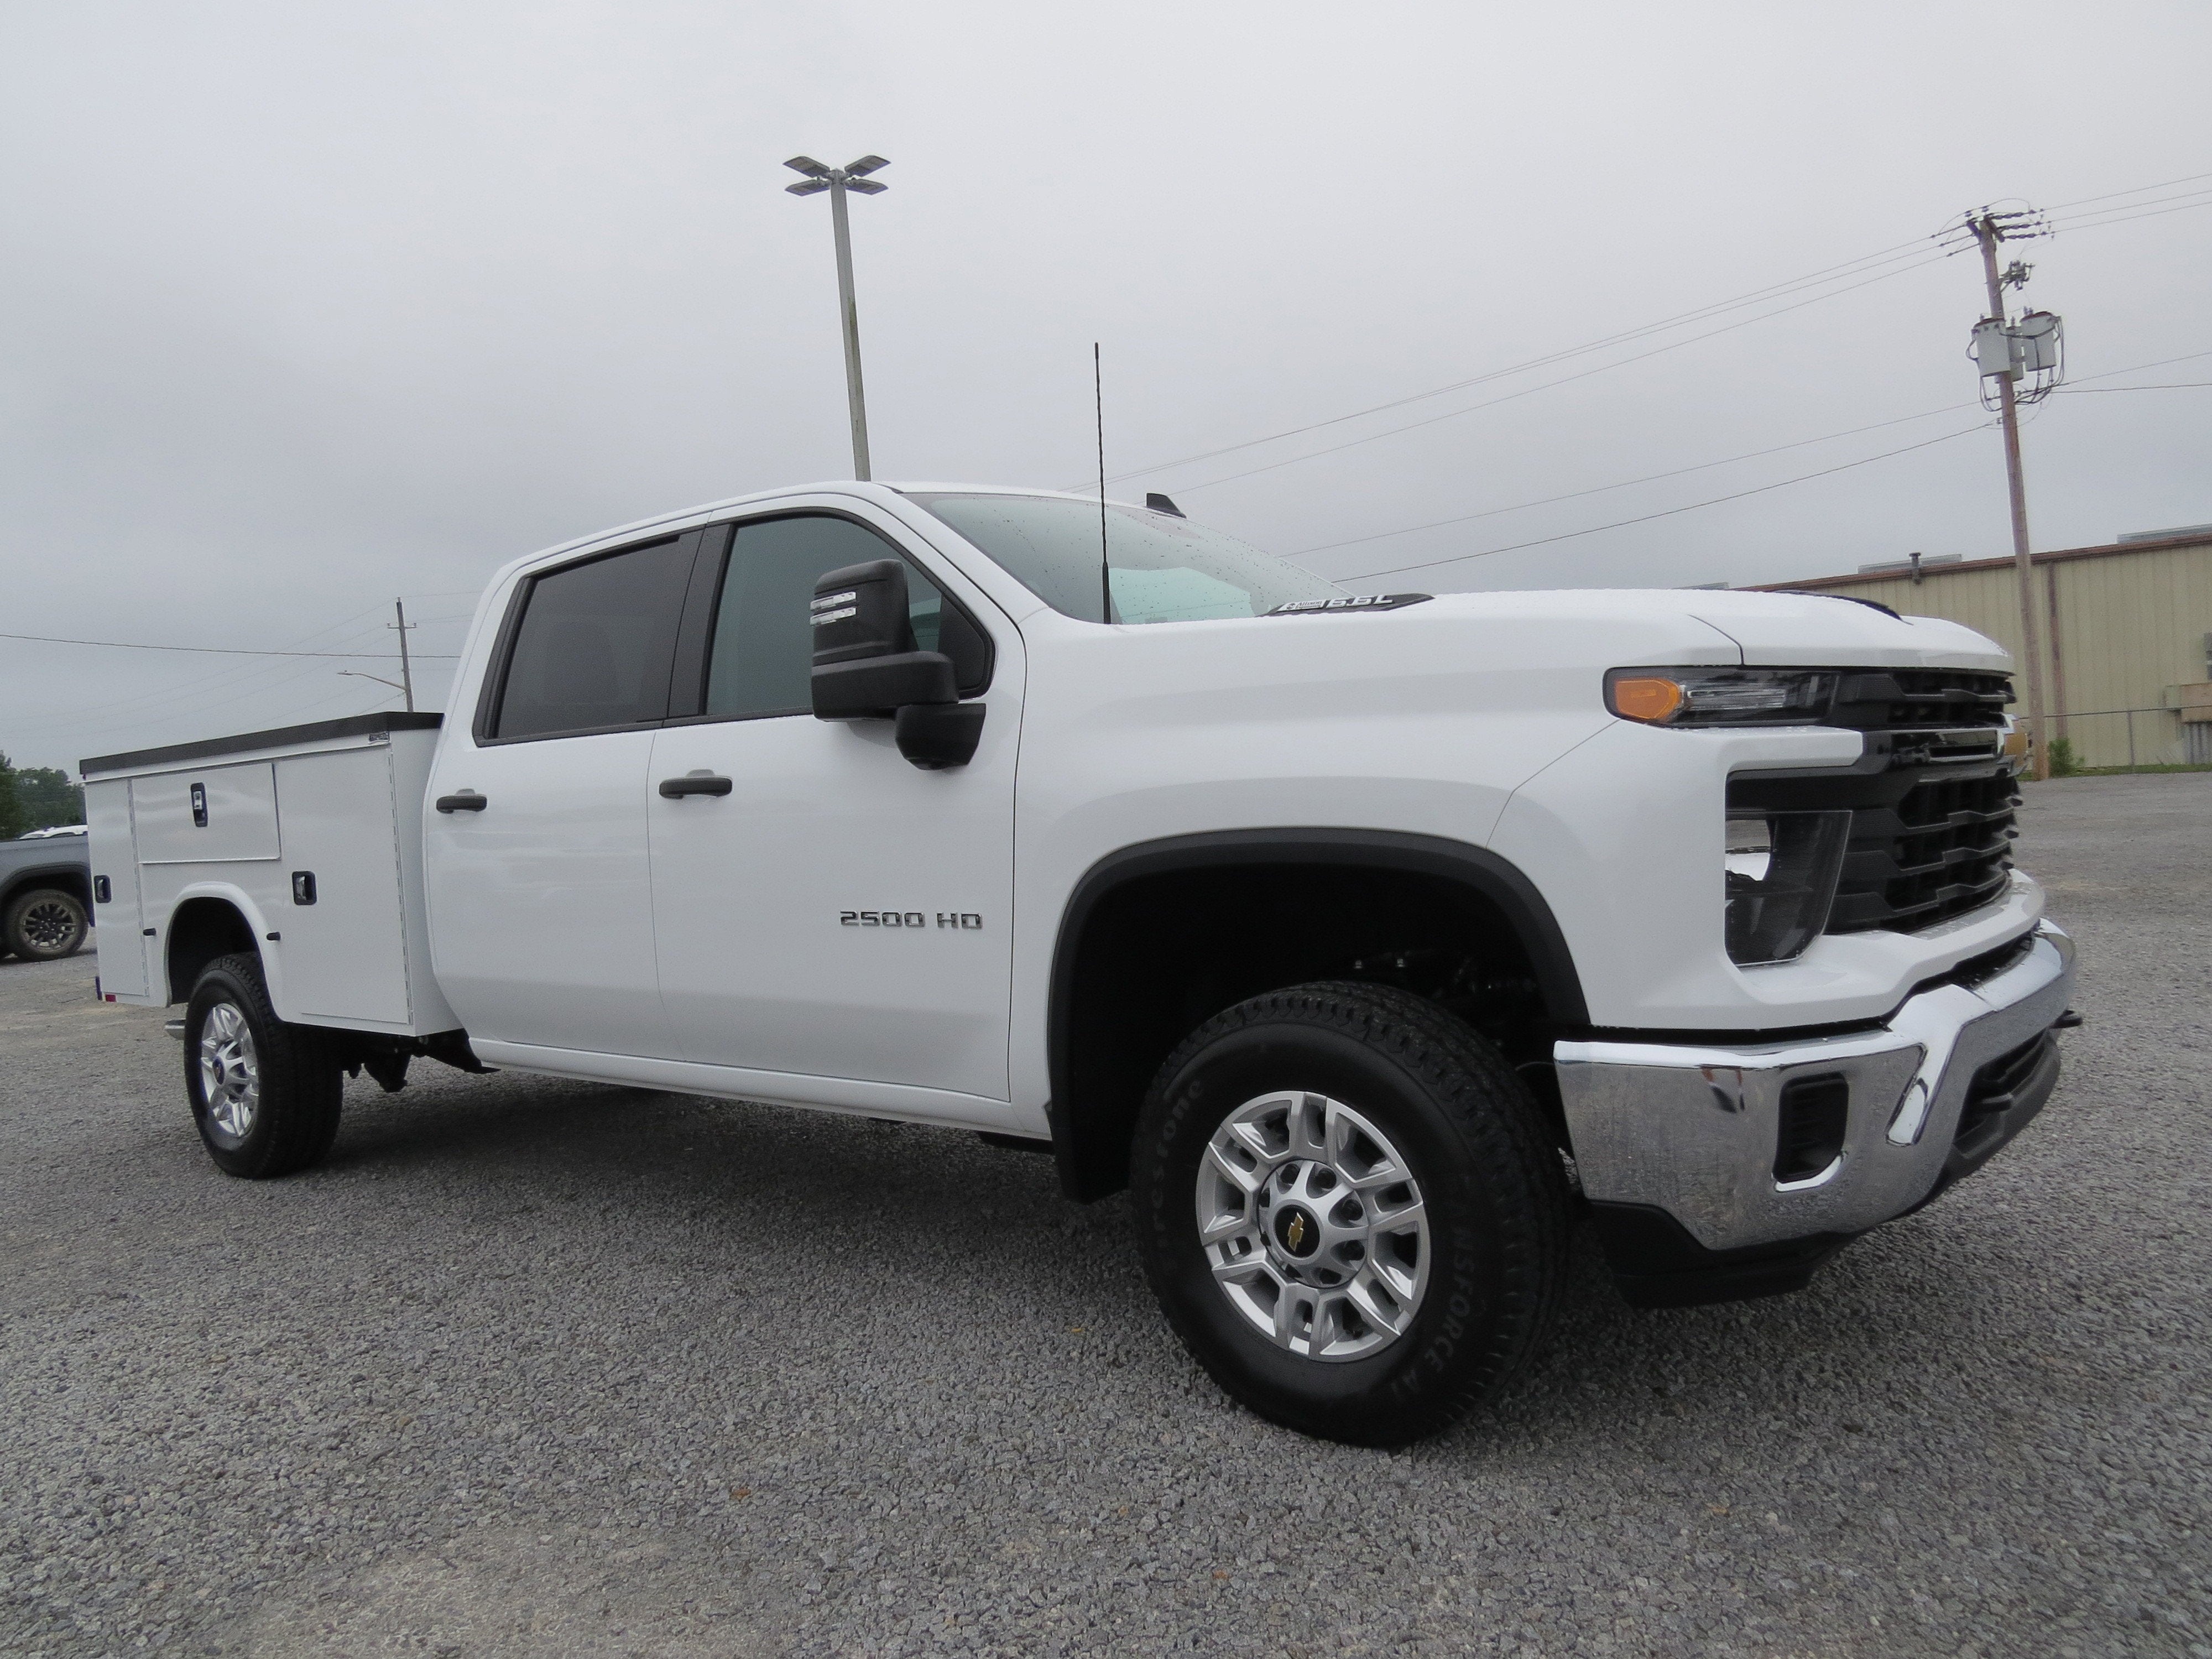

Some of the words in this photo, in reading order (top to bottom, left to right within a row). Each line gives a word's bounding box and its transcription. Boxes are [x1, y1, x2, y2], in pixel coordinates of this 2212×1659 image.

[1326, 594, 1393, 608] 6.6L
[839, 911, 926, 928] 2500
[936, 912, 983, 930] HD
